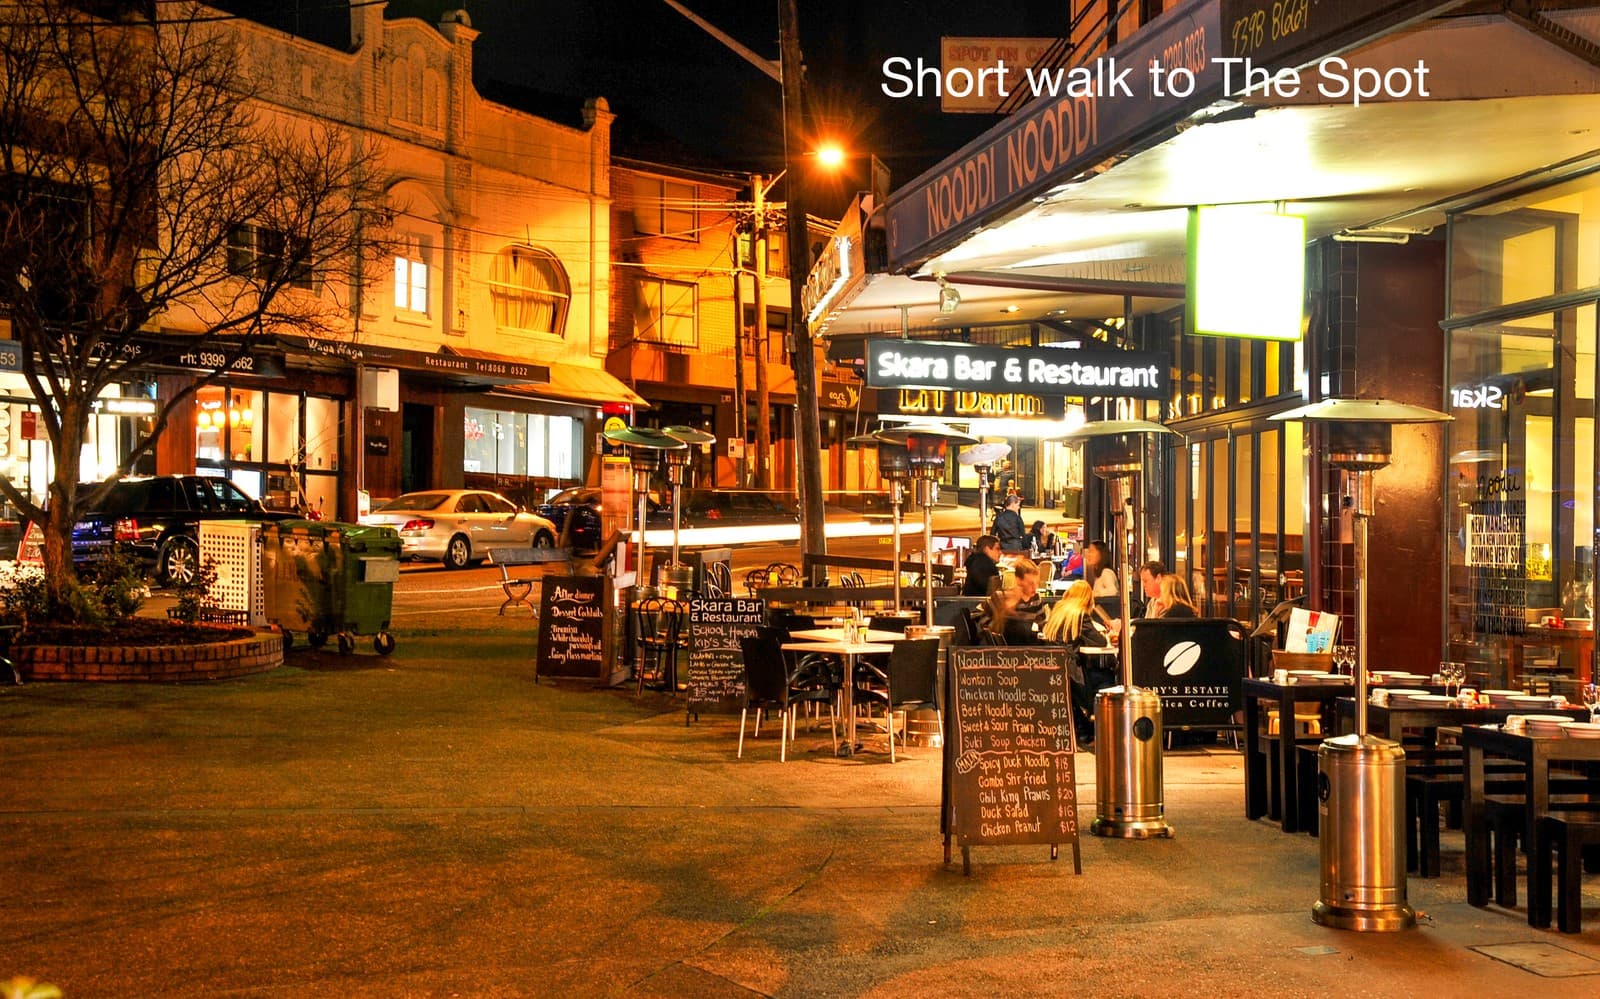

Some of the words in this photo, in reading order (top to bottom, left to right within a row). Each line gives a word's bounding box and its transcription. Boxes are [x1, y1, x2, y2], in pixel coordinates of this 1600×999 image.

[1232, 10, 1266, 57] 9398
[948, 46, 991, 62] SPOT
[996, 46, 1019, 62] ON
[1184, 26, 1205, 74] 8033
[926, 146, 995, 238] NOODDI
[200, 352, 226, 367] 9399
[232, 356, 253, 369] 662
[425, 356, 468, 369] Restaurant
[510, 366, 528, 376] 0522
[878, 351, 948, 380] Skara
[954, 353, 997, 381] Bar
[1004, 357, 1022, 383] &
[1028, 358, 1159, 388] Restaurant
[1471, 516, 1484, 533] NEW
[1485, 516, 1527, 534] MANAGEMENT
[1471, 546, 1494, 562] COMING
[1494, 546, 1509, 563] VERY
[550, 586, 574, 601] After
[574, 589, 595, 601] dinner
[551, 606, 577, 618] Dessert
[577, 606, 603, 617] Cocktails
[691, 600, 733, 612] Skara
[737, 600, 762, 612] Bar
[690, 613, 699, 622] &
[702, 613, 762, 623] Restaurant
[997, 651, 1019, 672] Soup
[1023, 650, 1058, 672] Specials
[996, 671, 1019, 688] Soup
[1048, 674, 1063, 686] $8
[960, 688, 995, 701] Chicken
[997, 687, 1027, 702] Noodle
[1028, 688, 1049, 706] Soup
[1050, 692, 1066, 704] $12
[1144, 686, 1178, 695] BY'S
[1184, 686, 1229, 695] ESTATE
[961, 703, 982, 717] Beef
[984, 702, 1013, 718] Noodle
[1015, 703, 1035, 719] Soup
[1051, 708, 1068, 719] $12
[1189, 699, 1230, 709] Coffee
[991, 718, 1009, 732] Sour
[1012, 719, 1035, 734] Prawn
[1037, 720, 1057, 738] Soup
[963, 737, 983, 749] Suki
[990, 735, 1010, 751] Soup
[1015, 736, 1047, 748] Chicken
[1055, 739, 1071, 751] $12
[980, 758, 1001, 775] Spicy
[1003, 754, 1021, 769] Duck
[1024, 755, 1051, 768] Noodle
[1023, 770, 1048, 785] fried
[1056, 771, 1072, 784] $15
[1000, 789, 1020, 809] King
[1023, 785, 1051, 801] Prawns
[1057, 787, 1074, 801] $20
[981, 806, 1002, 819] Duck
[1006, 803, 1029, 818] Salad
[1058, 805, 1074, 818] $16
[980, 823, 1011, 838] Chicken
[1014, 816, 1042, 833] Peanut
[1060, 820, 1076, 834] $12
